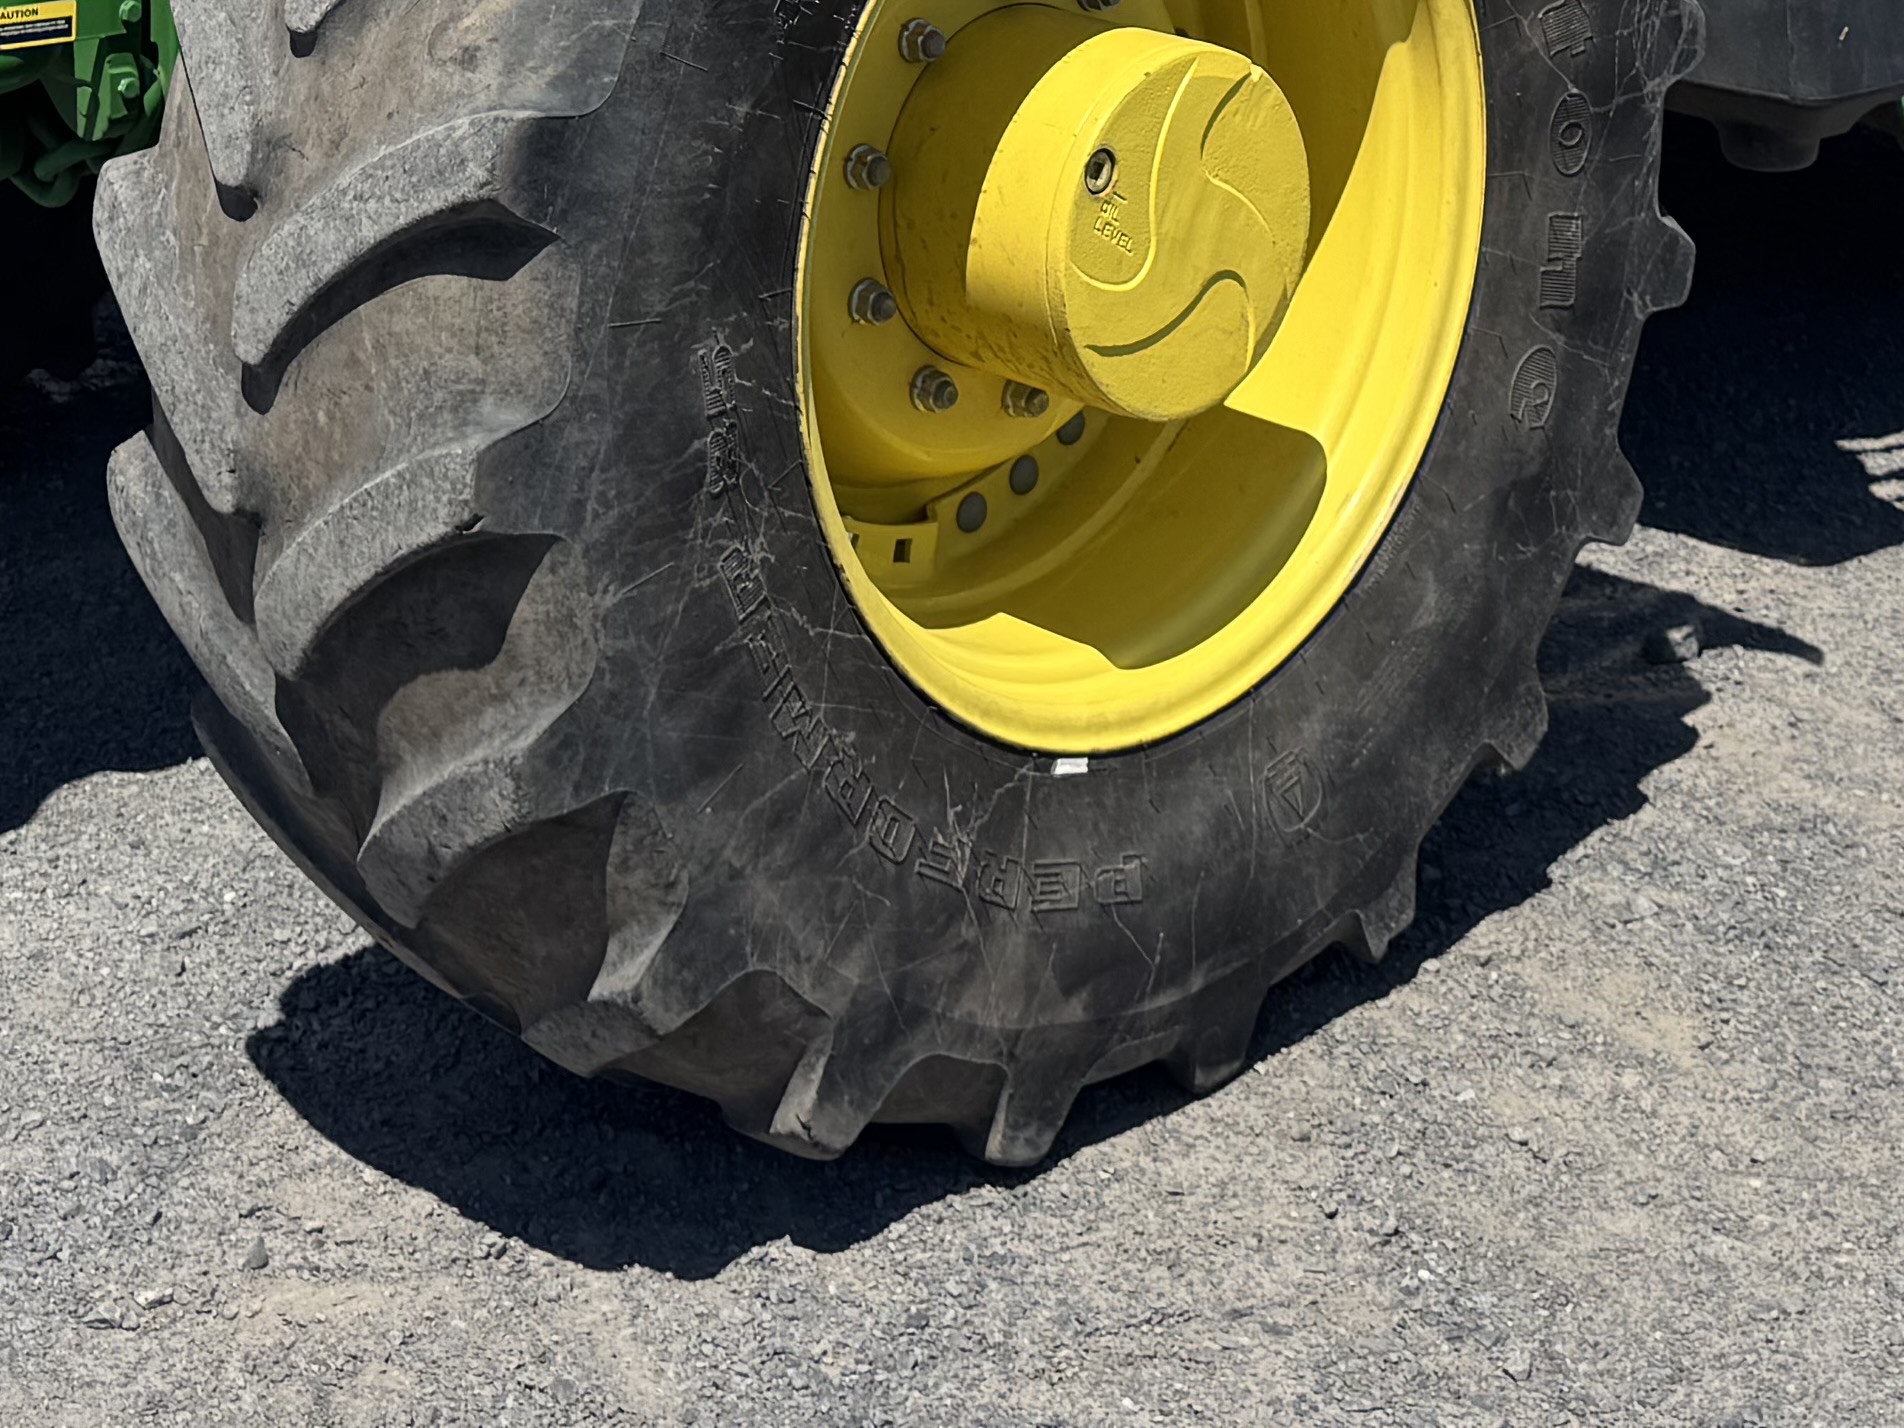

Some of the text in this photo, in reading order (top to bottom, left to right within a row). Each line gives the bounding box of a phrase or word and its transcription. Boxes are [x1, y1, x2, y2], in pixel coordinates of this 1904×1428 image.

[1100, 200, 1120, 225] OIL
[1094, 215, 1135, 256] LEVEL
[719, 545, 1145, 913] PERFORMER
